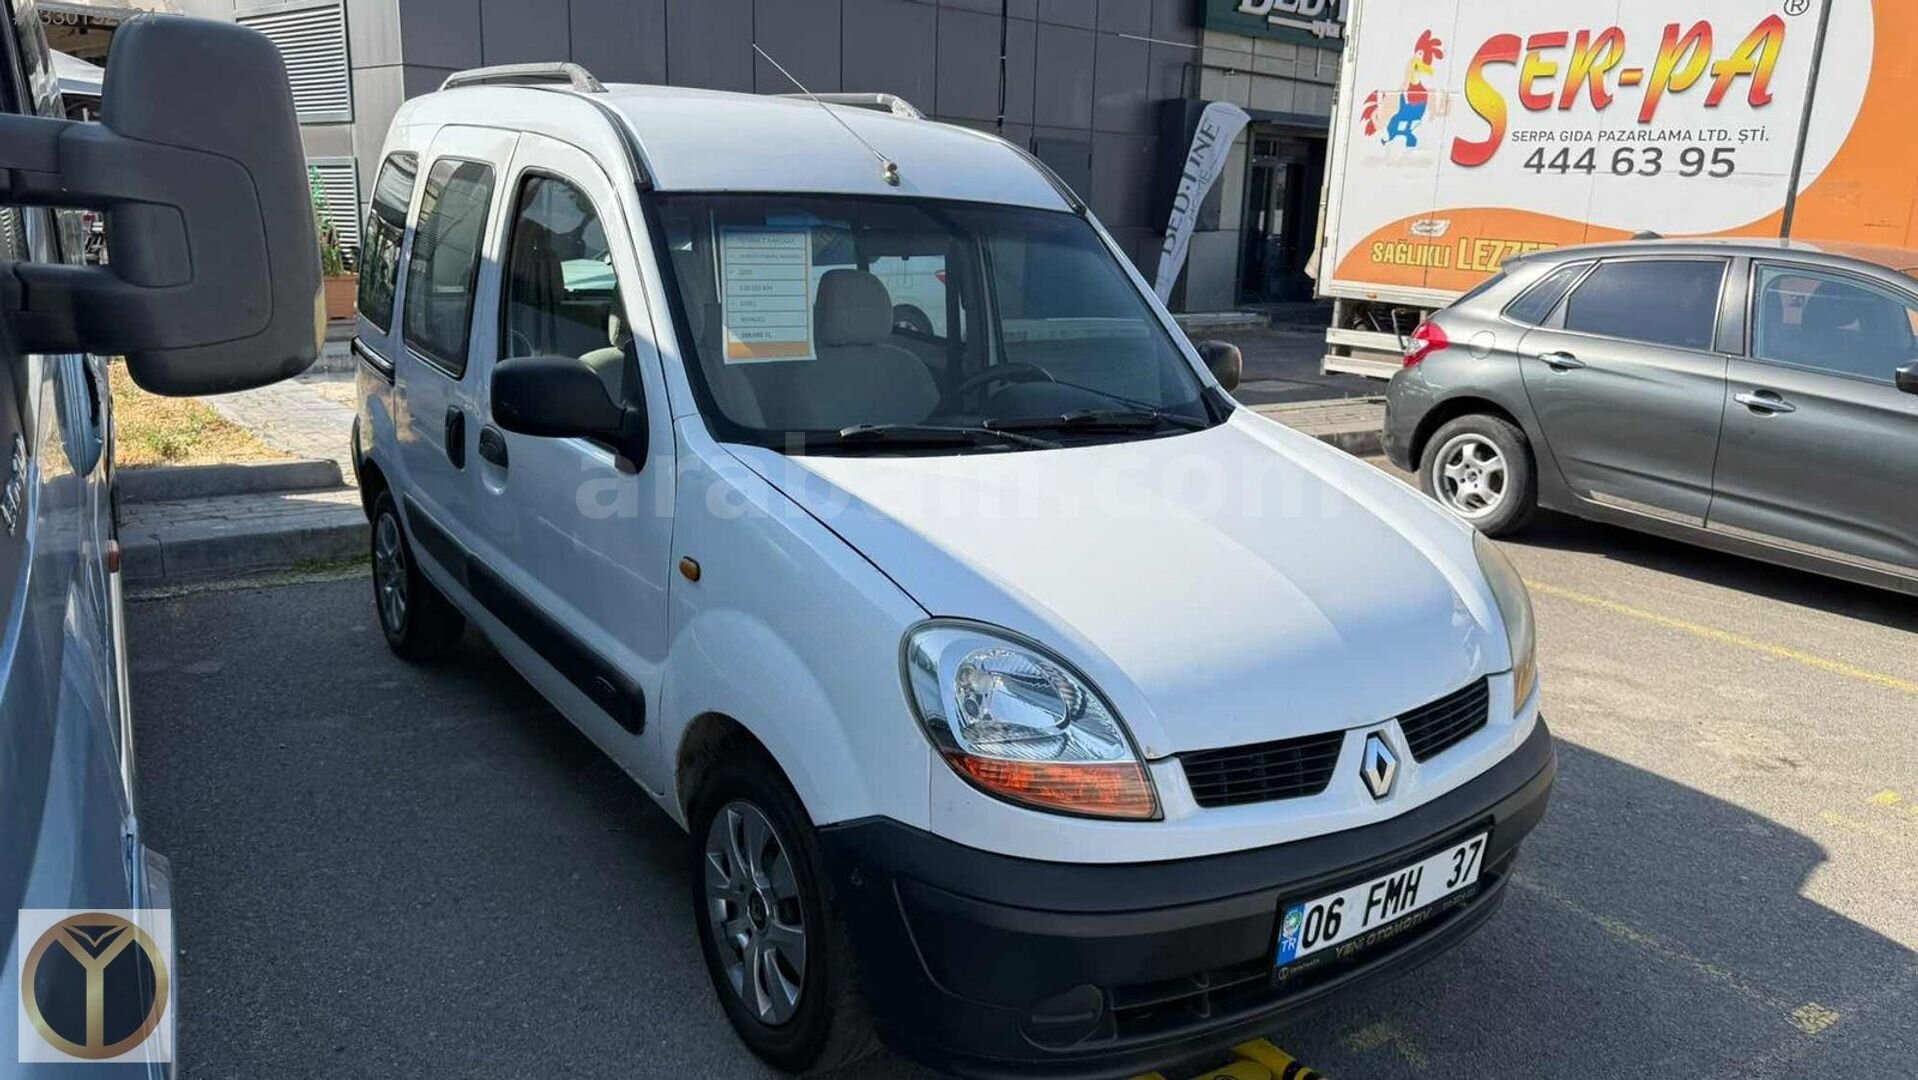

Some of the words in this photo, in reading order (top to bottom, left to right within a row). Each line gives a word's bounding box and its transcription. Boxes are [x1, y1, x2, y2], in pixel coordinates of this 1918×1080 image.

[1511, 130, 1555, 142] SERPA
[1559, 130, 1593, 142] GIDA
[1597, 130, 1693, 142] PAZARLAMA
[1698, 129, 1732, 142] LTD.
[1738, 126, 1769, 144] ŞTİ.
[1523, 147, 1597, 175] 444
[1611, 147, 1663, 176] 63
[1678, 147, 1736, 178] 95
[1371, 239, 1451, 268] SAĞLIKLI
[1302, 898, 1344, 949] 06
[1362, 866, 1424, 927] FMH
[1446, 839, 1484, 888] 37
[1281, 938, 1296, 952] TR
